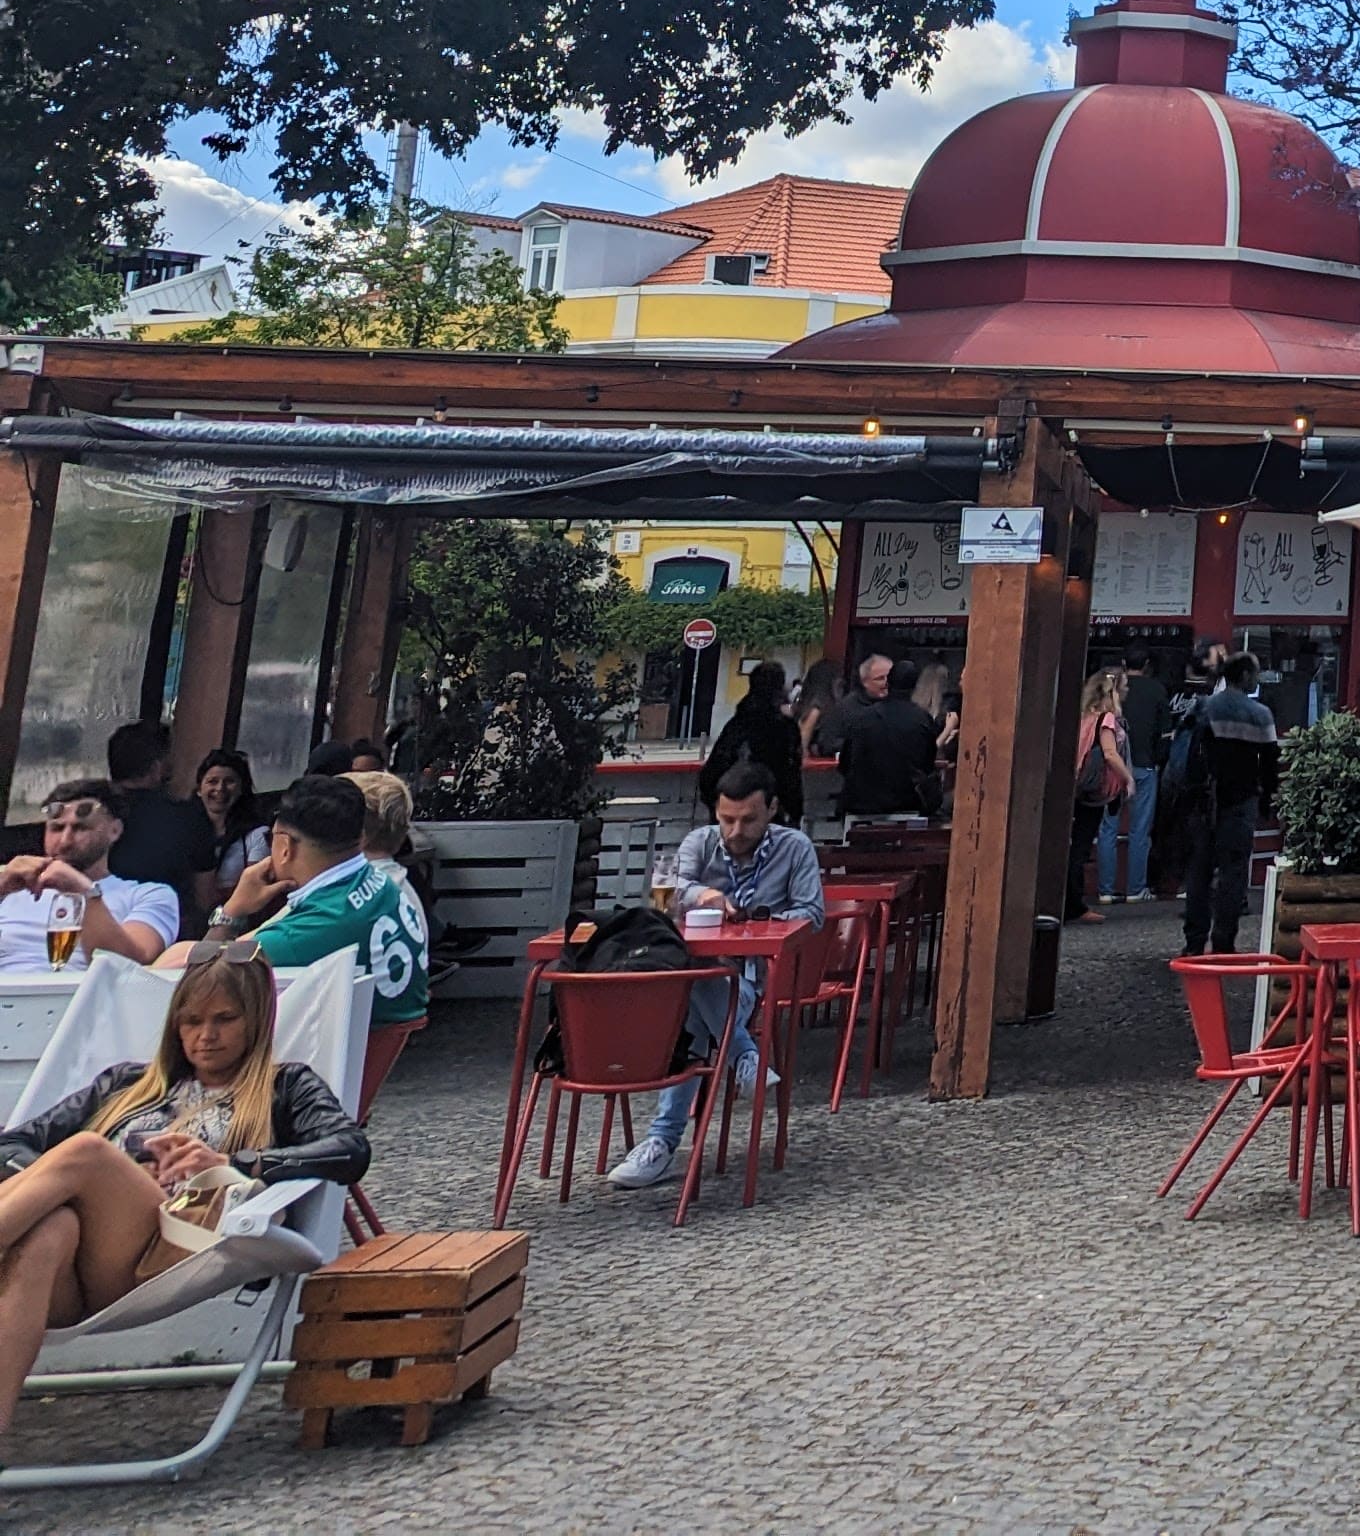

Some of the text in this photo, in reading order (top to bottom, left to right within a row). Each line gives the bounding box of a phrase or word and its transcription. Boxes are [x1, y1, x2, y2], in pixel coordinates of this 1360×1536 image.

[873, 531, 919, 560] ALL Day
[660, 585, 706, 595] JANIS
[1095, 616, 1121, 624] AWAY
